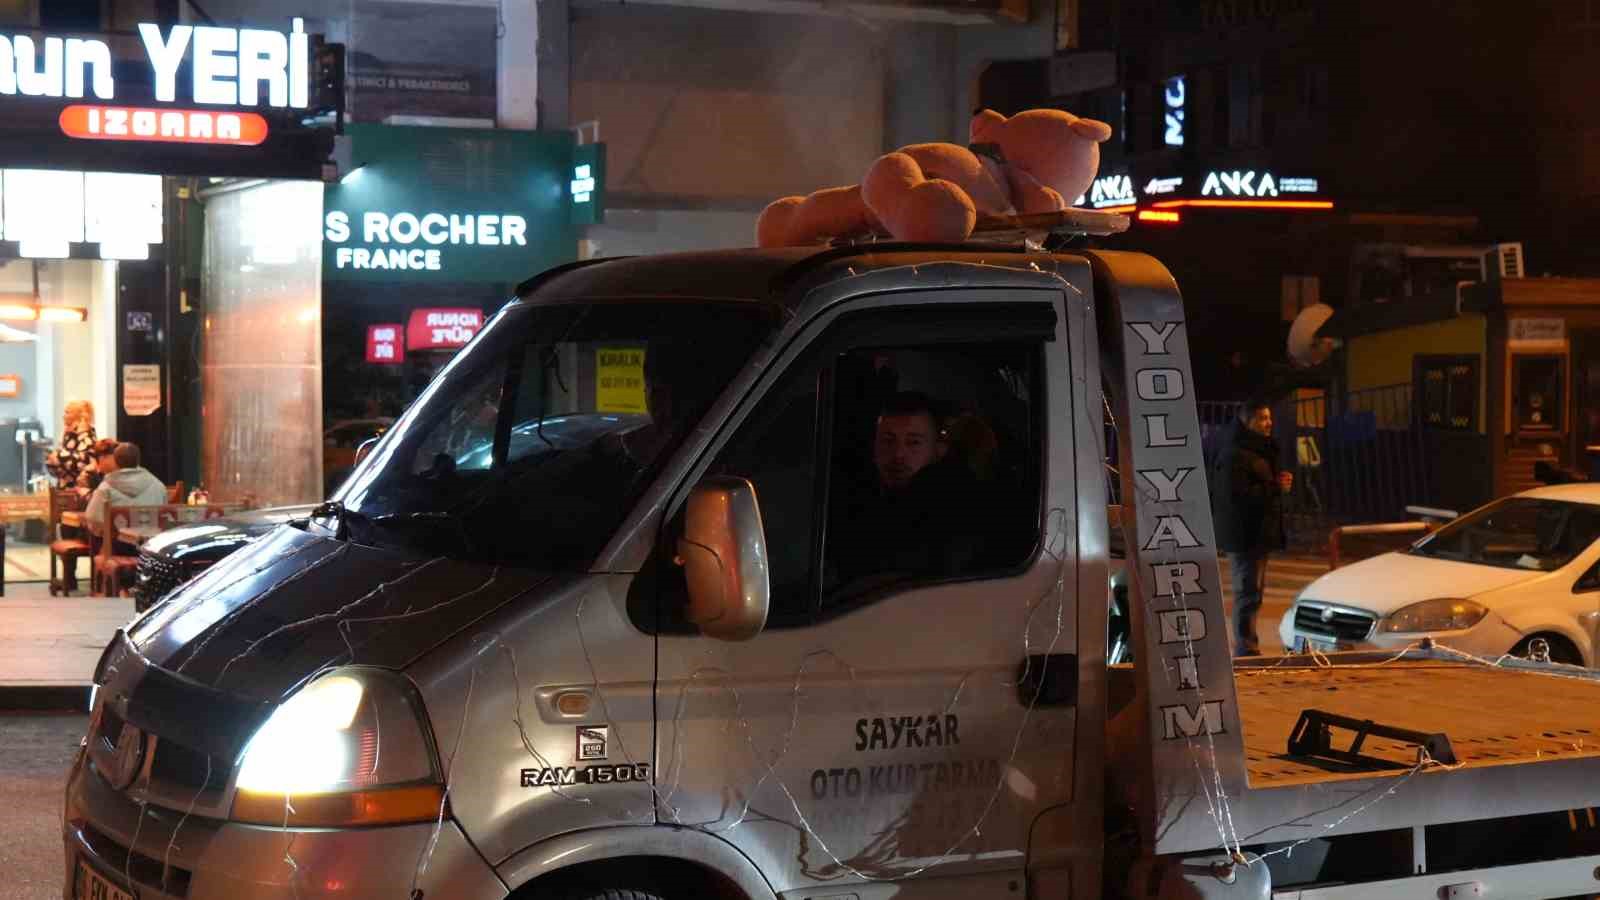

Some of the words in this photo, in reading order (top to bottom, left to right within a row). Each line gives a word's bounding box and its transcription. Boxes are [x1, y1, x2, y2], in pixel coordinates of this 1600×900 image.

[138, 17, 308, 108] YERİ
[322, 210, 351, 243] S
[363, 211, 527, 246] ROCHER
[336, 247, 441, 270] FRANCE
[855, 714, 960, 751] SAYKAR
[521, 766, 576, 788] RAM
[585, 763, 651, 785] 1500
[811, 768, 861, 800] OTO
